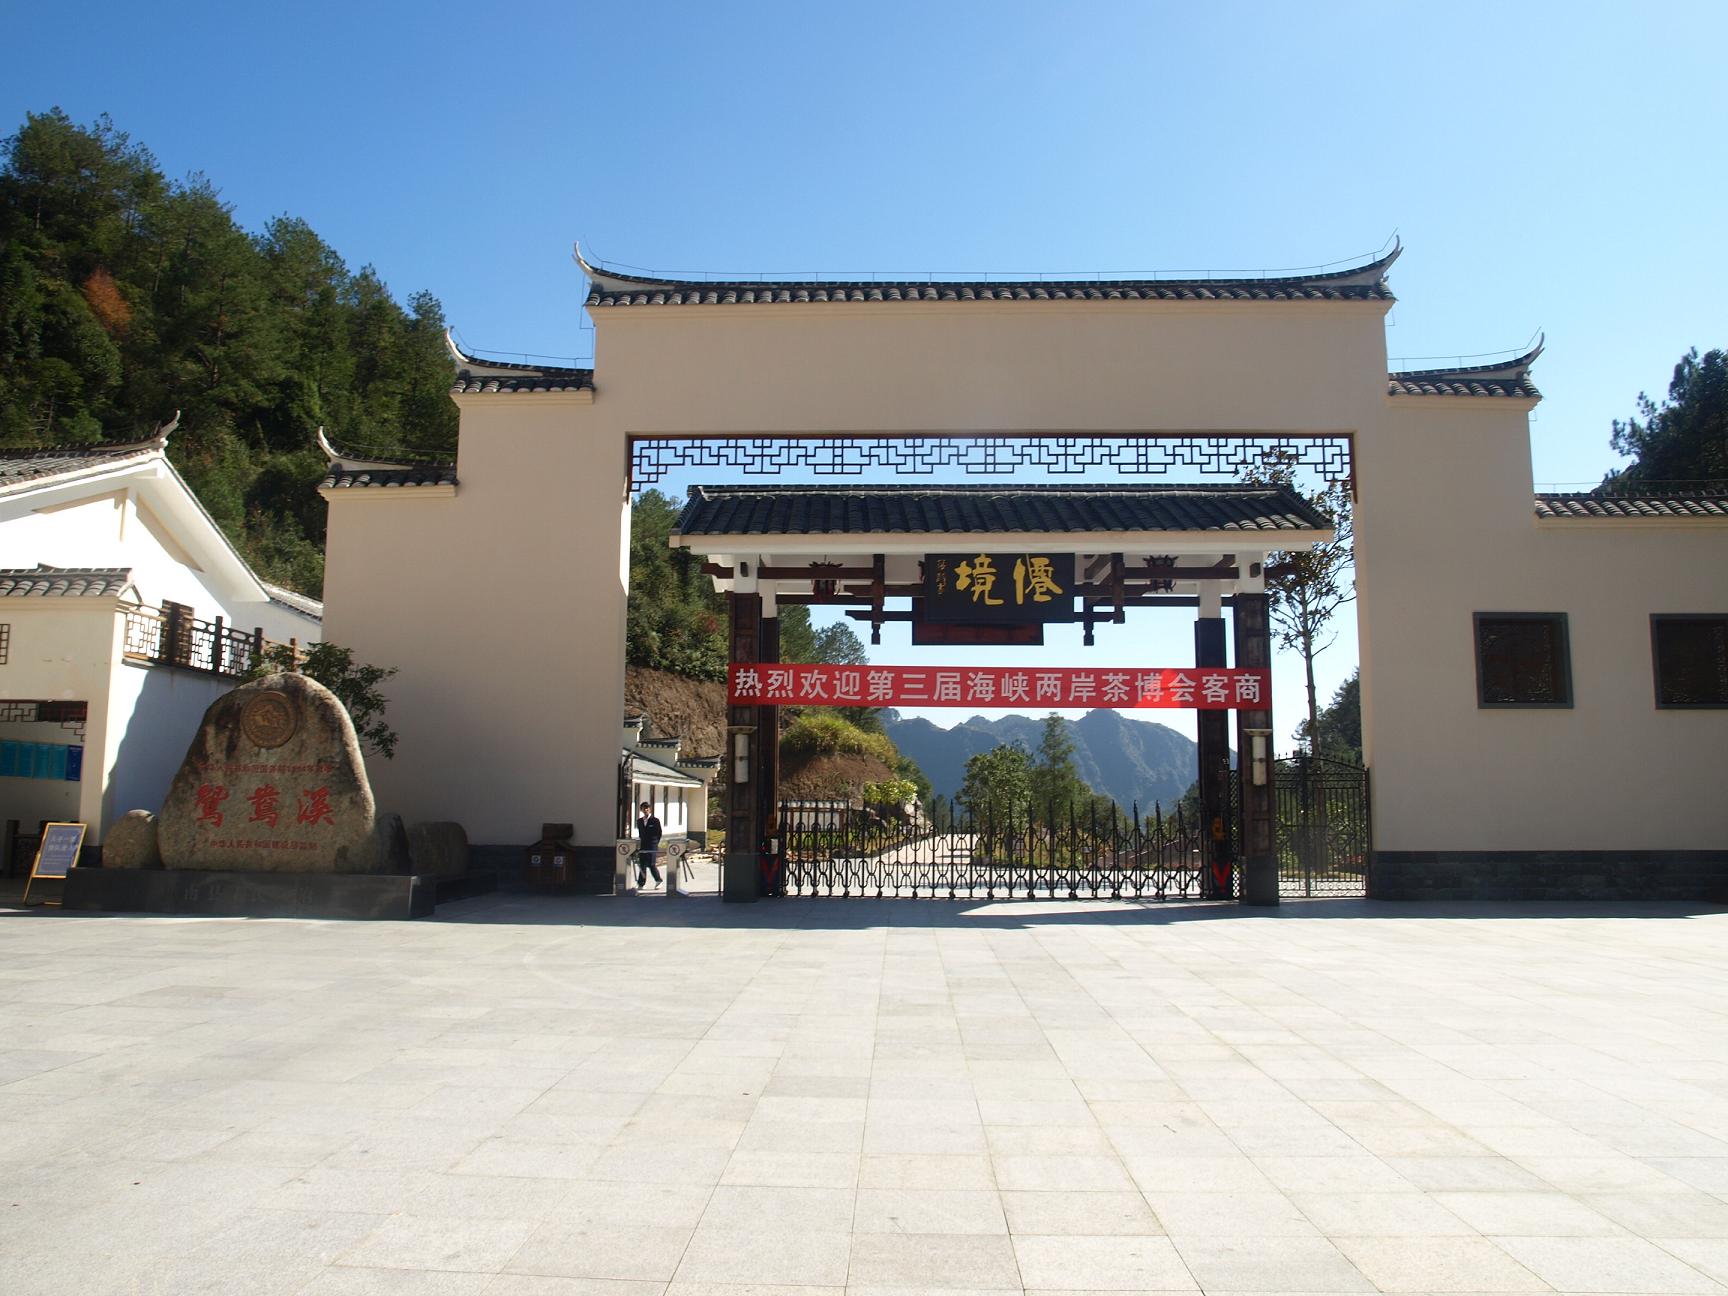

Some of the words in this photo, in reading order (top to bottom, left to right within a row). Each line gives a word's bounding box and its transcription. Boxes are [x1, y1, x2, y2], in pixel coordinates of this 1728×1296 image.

[734, 667, 1262, 704] 热烈欢迎第三届海峡两岸茶博会客商
